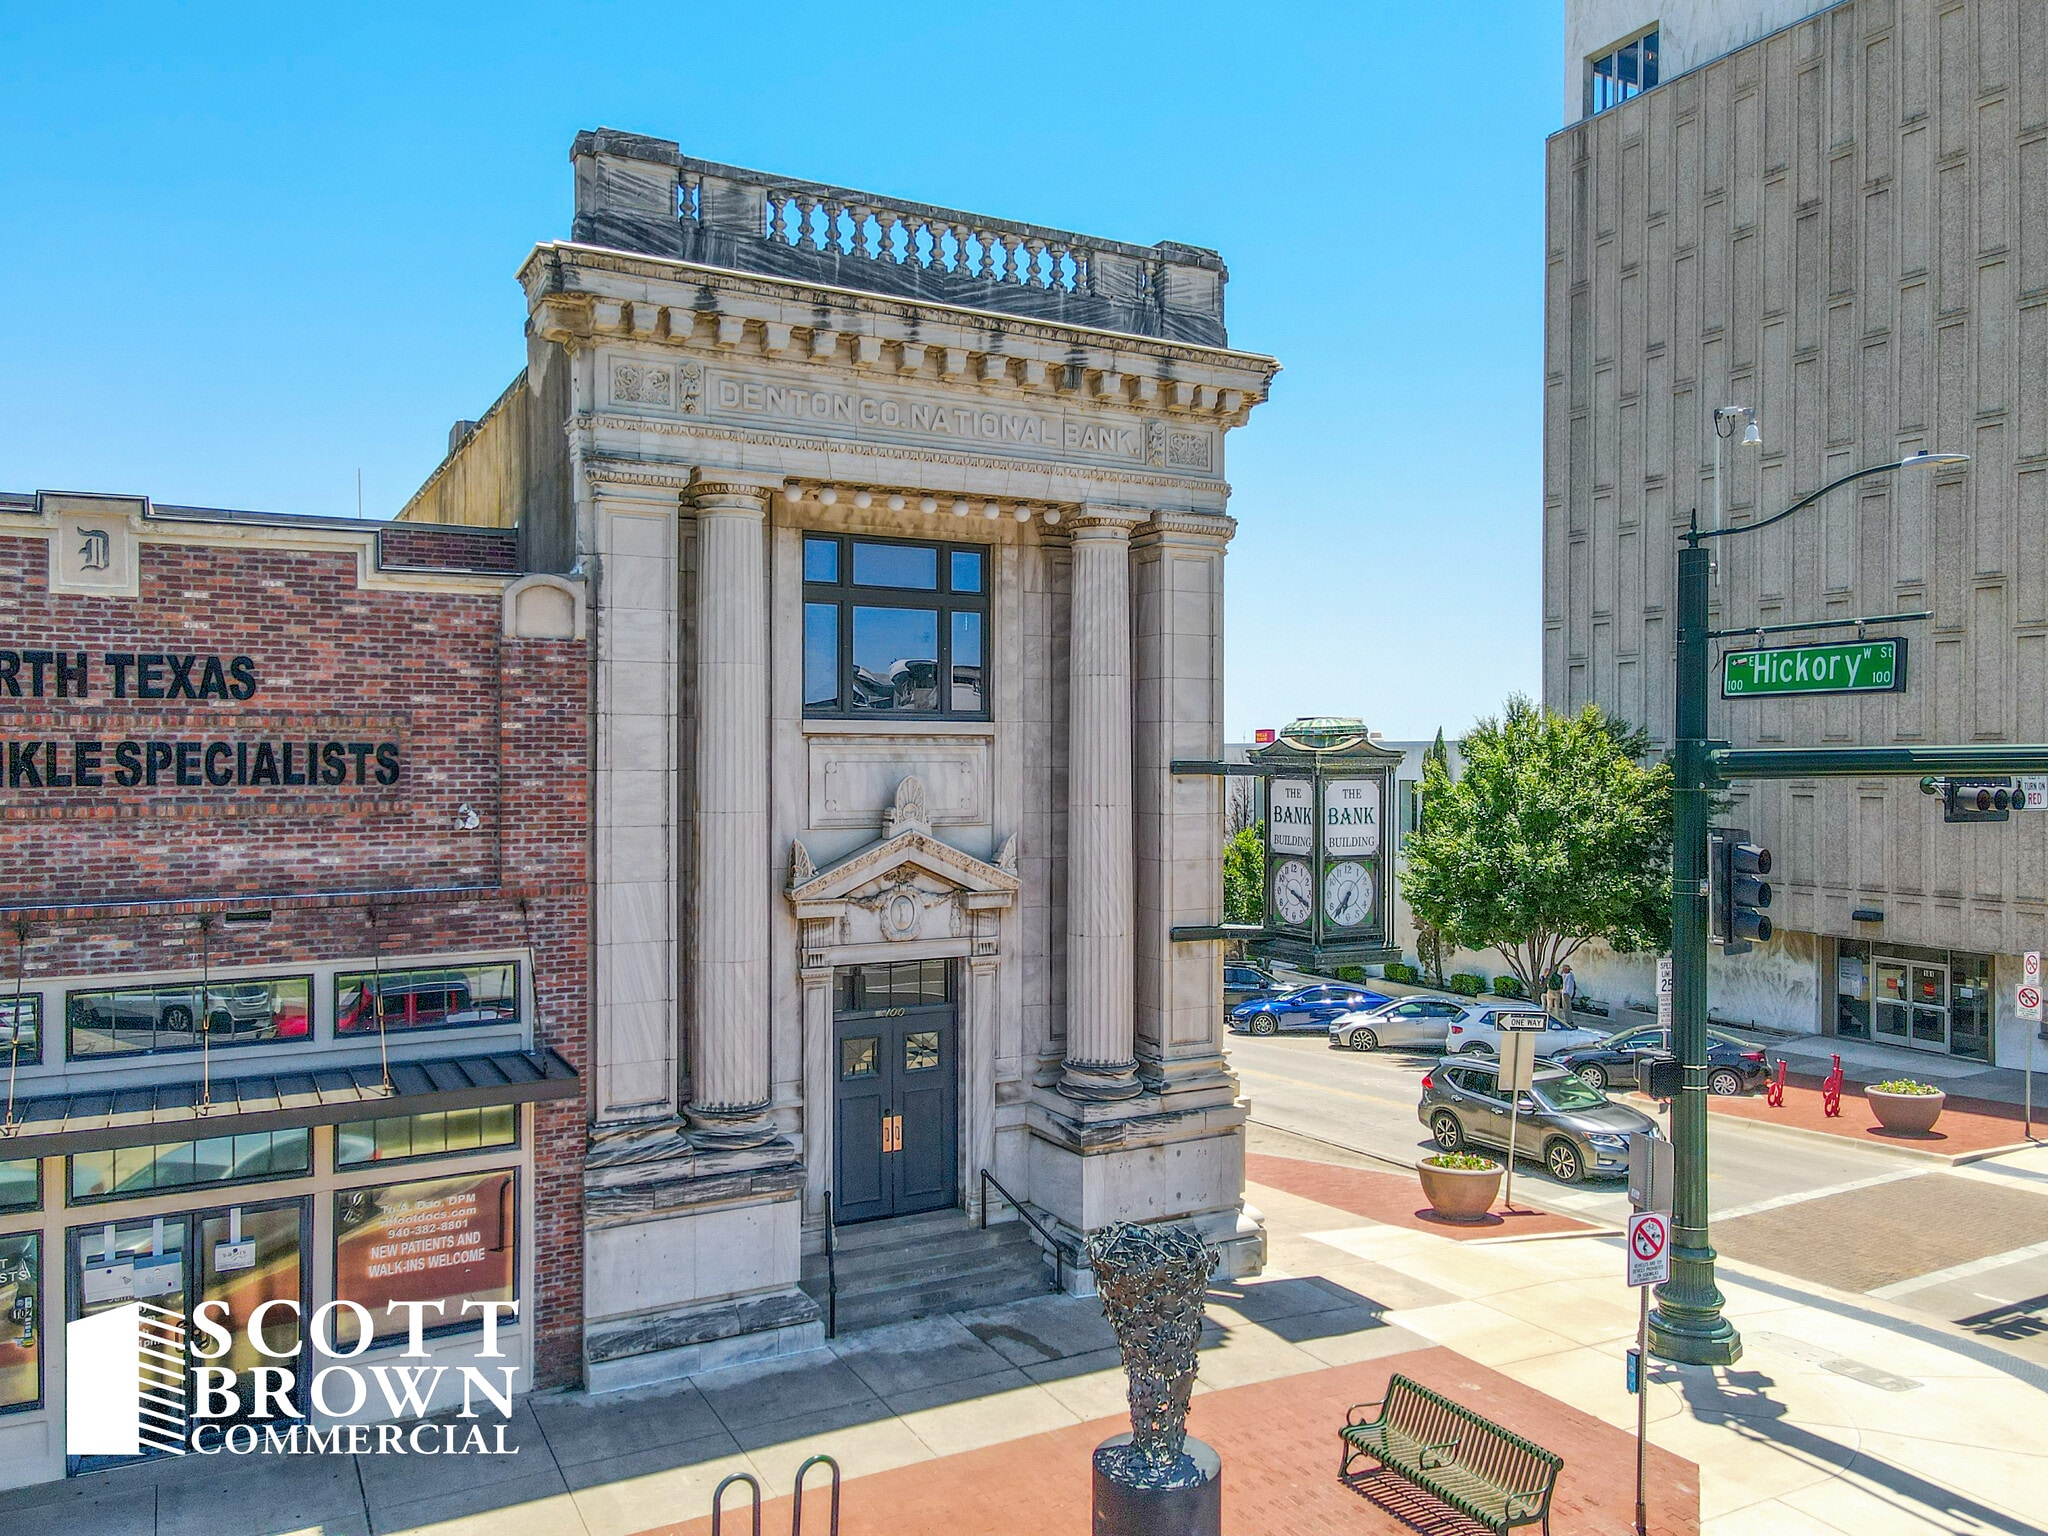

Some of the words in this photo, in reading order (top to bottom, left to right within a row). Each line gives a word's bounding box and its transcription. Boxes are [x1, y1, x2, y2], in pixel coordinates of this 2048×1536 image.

[719, 380, 853, 421] DENTON
[859, 399, 907, 427] CO.
[910, 404, 1057, 447] NATIONAL
[1753, 652, 1861, 687] Hickory
[1863, 648, 1872, 659] W
[1881, 646, 1892, 659] St
[105, 653, 256, 700] TEXAS
[1872, 671, 1891, 683] 100
[1728, 680, 1743, 691] 100
[0, 741, 102, 788] KLE
[115, 741, 399, 788] SPECIALISTS
[2024, 782, 2037, 791] TURN
[1285, 788, 1301, 799] THE
[1342, 789, 1362, 799] THE
[2028, 792, 2042, 805] RED
[1274, 805, 1312, 825] BANK
[1328, 807, 1375, 825] BANK
[1274, 834, 1311, 849] BUILDING
[1329, 836, 1375, 848] BUILDING
[1661, 979, 1673, 992] 25
[886, 1007, 906, 1018] 100
[1511, 1019, 1525, 1027] ONE
[1527, 1019, 1541, 1027] WAY
[447, 1193, 476, 1205] DPM
[388, 1219, 469, 1239] 940-382-8801
[371, 1244, 398, 1260] NEW
[401, 1235, 454, 1256] PATIENTS
[456, 1231, 481, 1247] AND
[368, 1257, 425, 1278] WALK-INS
[427, 1247, 486, 1269] WELCOME
